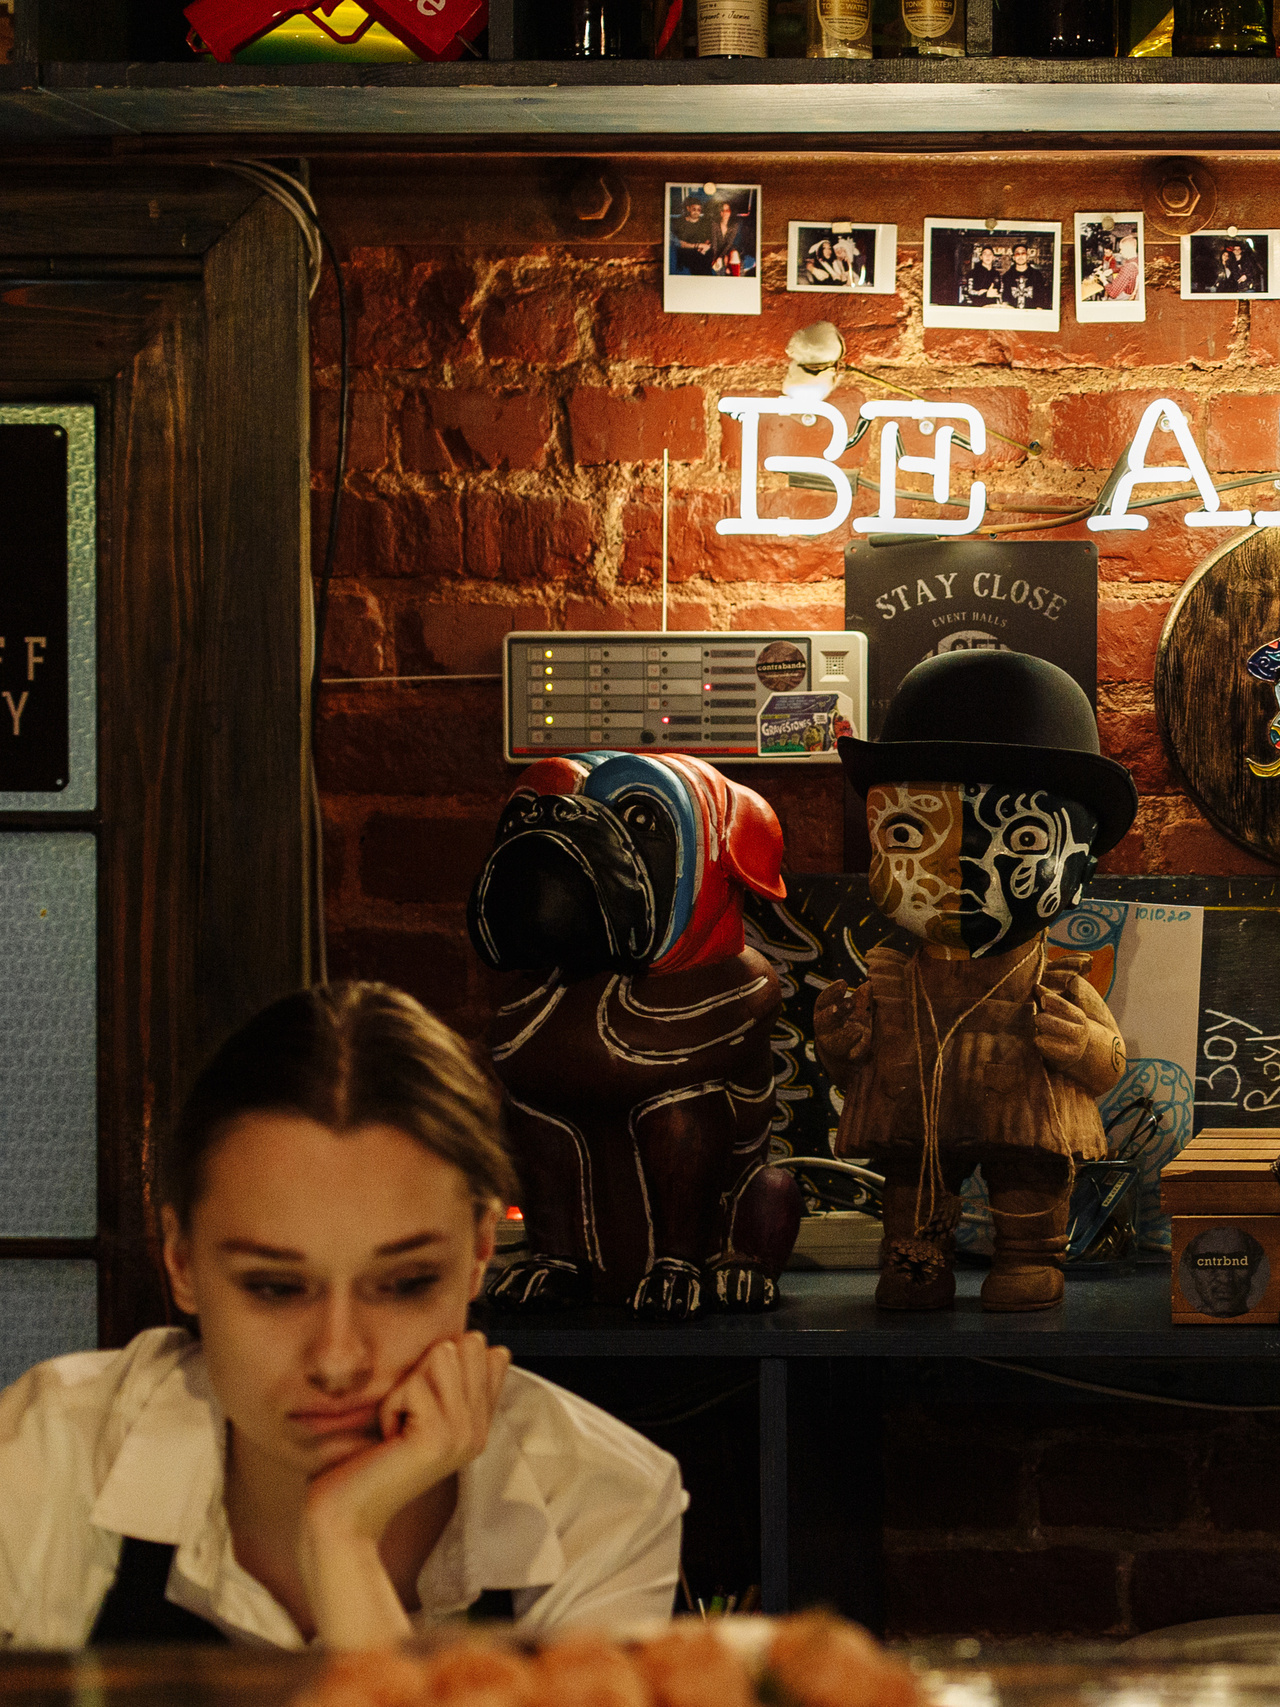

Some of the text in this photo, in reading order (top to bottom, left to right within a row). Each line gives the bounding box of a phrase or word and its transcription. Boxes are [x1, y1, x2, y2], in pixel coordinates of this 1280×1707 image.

[715, 396, 987, 536] BE
[875, 572, 1068, 621] STAY CLOSE
[932, 611, 1008, 628] EVENT HALLS
[757, 660, 806, 672] contrabanda
[1135, 907, 1191, 922] 10.10.20
[1197, 1255, 1249, 1266] cntrbnd
